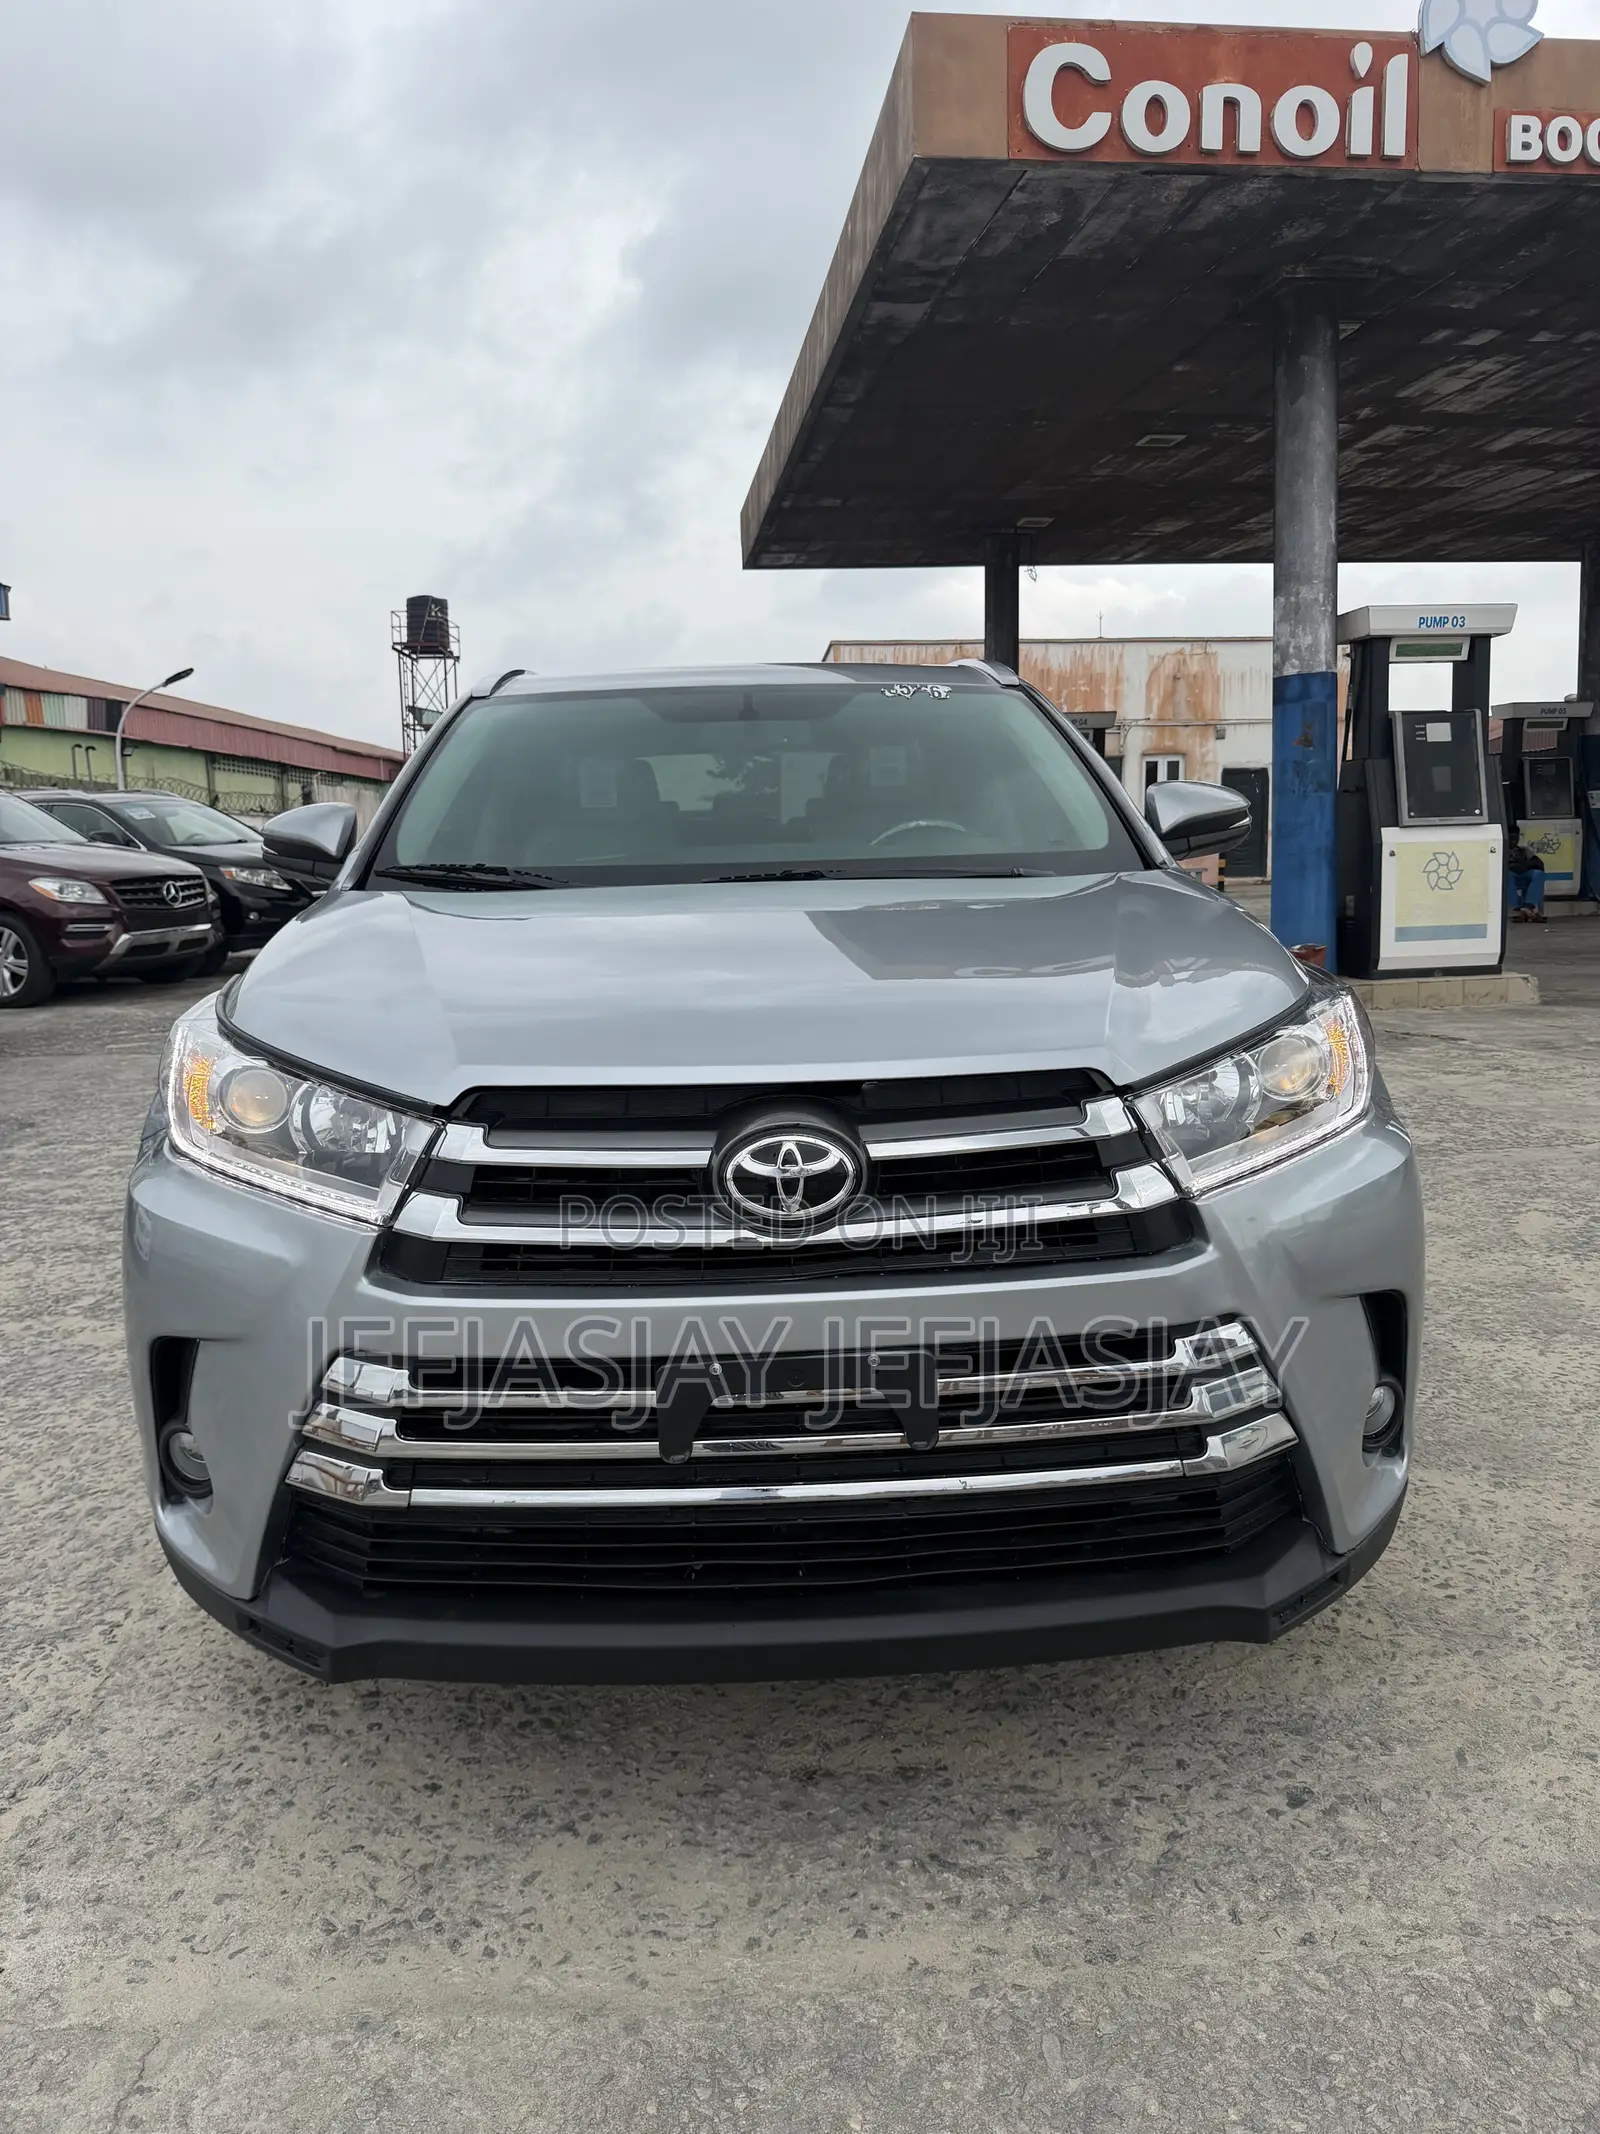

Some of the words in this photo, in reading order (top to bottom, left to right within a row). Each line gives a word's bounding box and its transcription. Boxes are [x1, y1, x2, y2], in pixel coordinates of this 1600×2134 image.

[1023, 42, 1409, 160] Conoil
[1418, 616, 1449, 628] PUMP
[1451, 615, 1466, 628] 03
